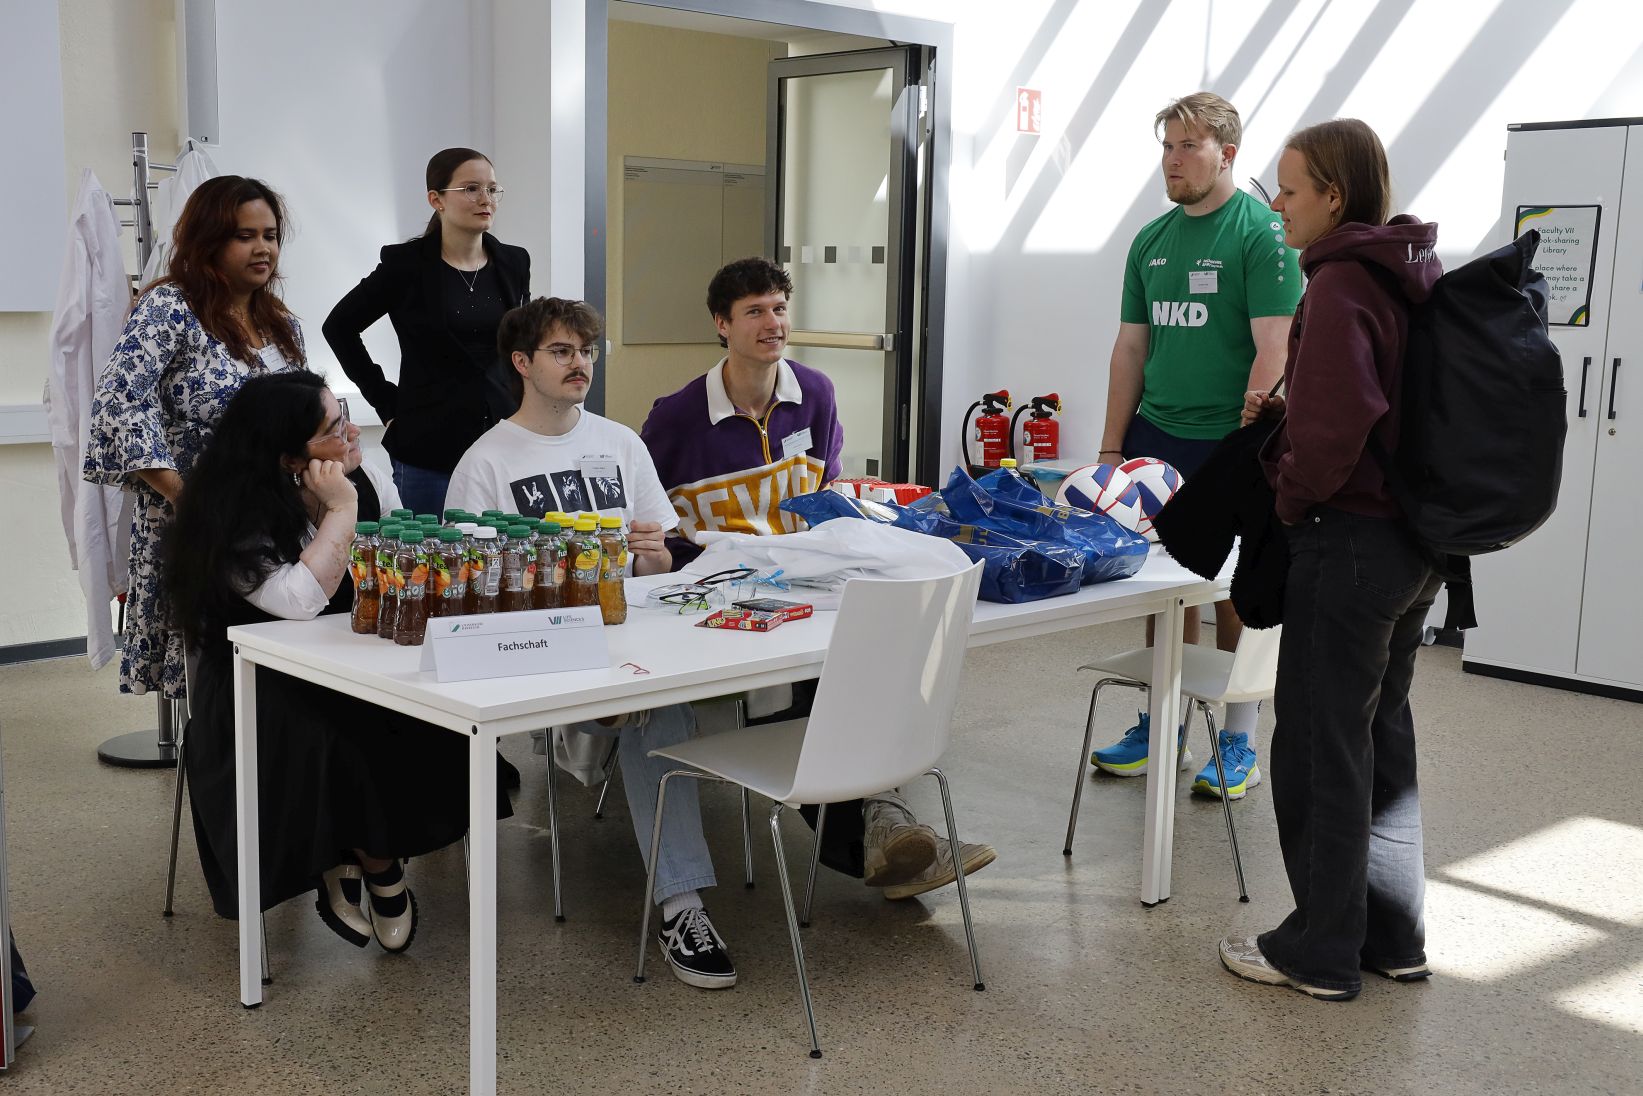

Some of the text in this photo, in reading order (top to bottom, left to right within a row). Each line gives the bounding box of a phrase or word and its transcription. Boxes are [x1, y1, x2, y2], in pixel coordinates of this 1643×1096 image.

[1538, 226, 1563, 235] Faculty
[1539, 236, 1580, 246] ook-sharing
[1542, 246, 1567, 255] Library
[1534, 264, 1577, 274] place where
[1562, 274, 1578, 282] take
[1152, 301, 1208, 327] NKD
[497, 639, 548, 651] Fachschaft
